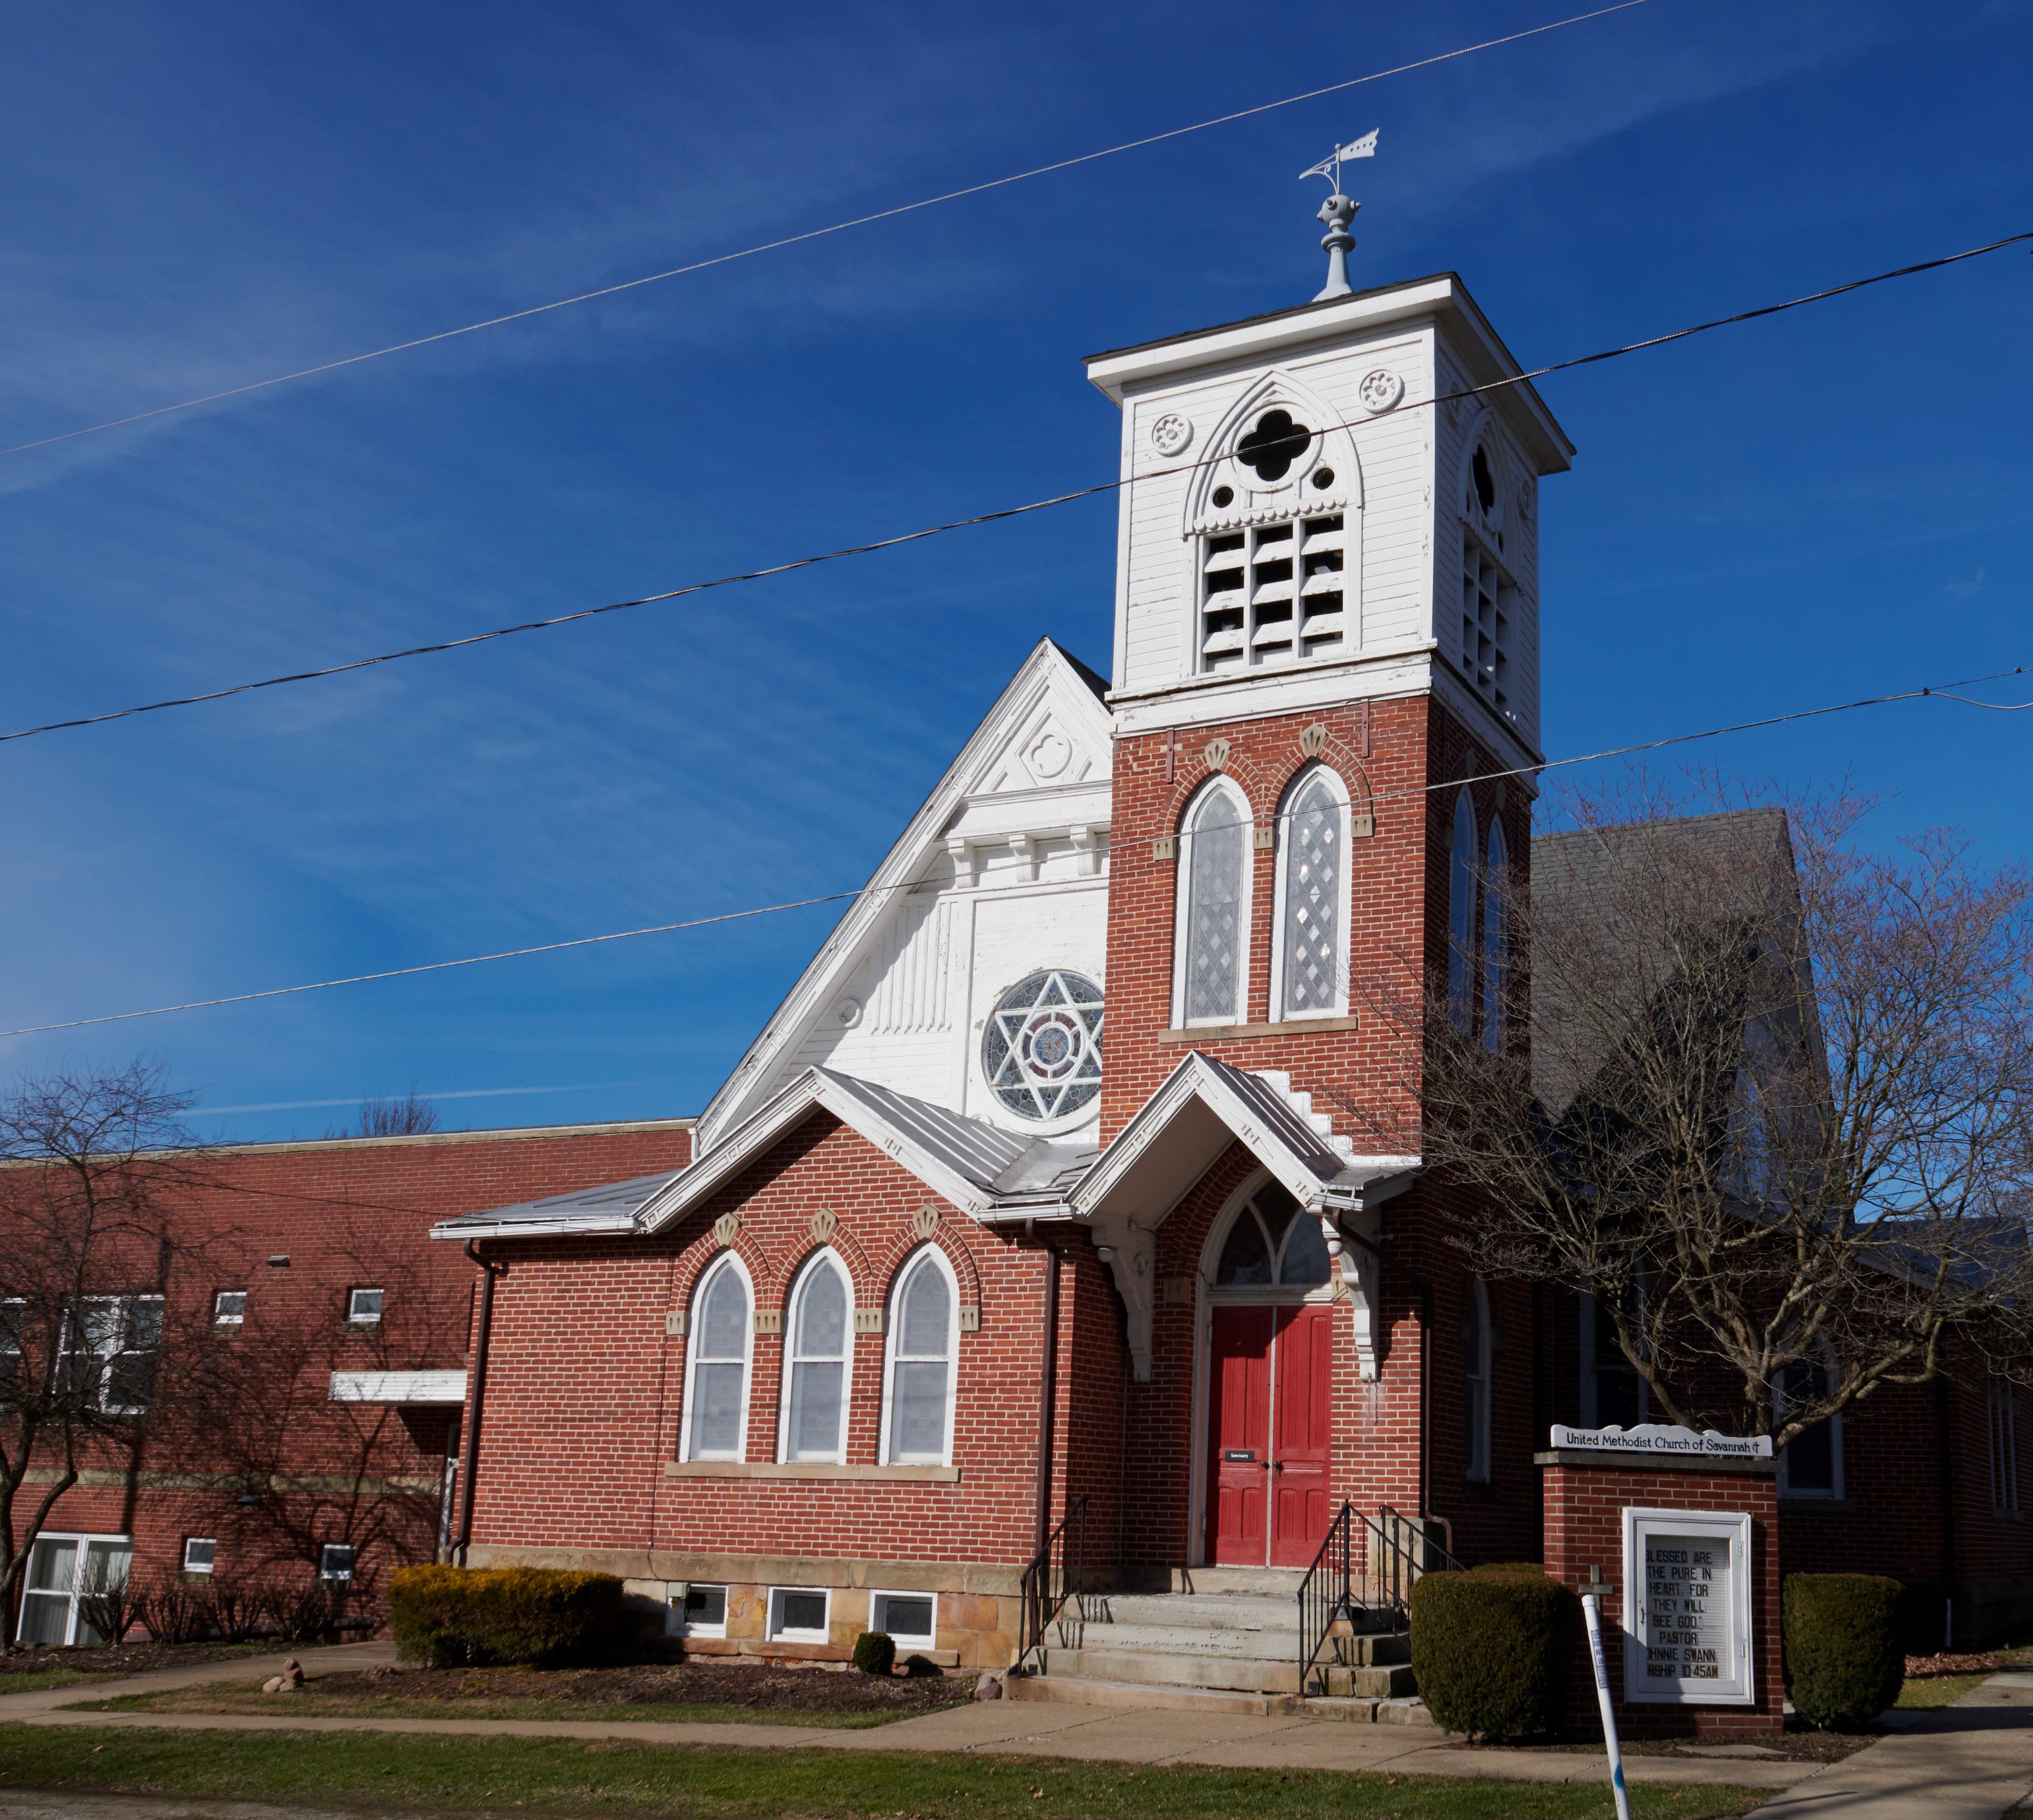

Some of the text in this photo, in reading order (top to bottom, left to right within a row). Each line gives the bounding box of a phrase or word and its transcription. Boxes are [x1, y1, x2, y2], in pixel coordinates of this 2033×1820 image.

[1567, 1432, 1750, 1452] United Methodist Church of Savannah
[1694, 1552, 1712, 1565] ARE
[1647, 1566, 1712, 1581] THE PURE IN
[1690, 1584, 1709, 1597] FOR
[1653, 1598, 1704, 1613] THEY WILL
[1652, 1615, 1672, 1628] SEE
[1660, 1631, 1698, 1645] PASTOR
[1647, 1647, 1716, 1662] OHNNIE SWANN
[1647, 1664, 1676, 1677] RSHIP
